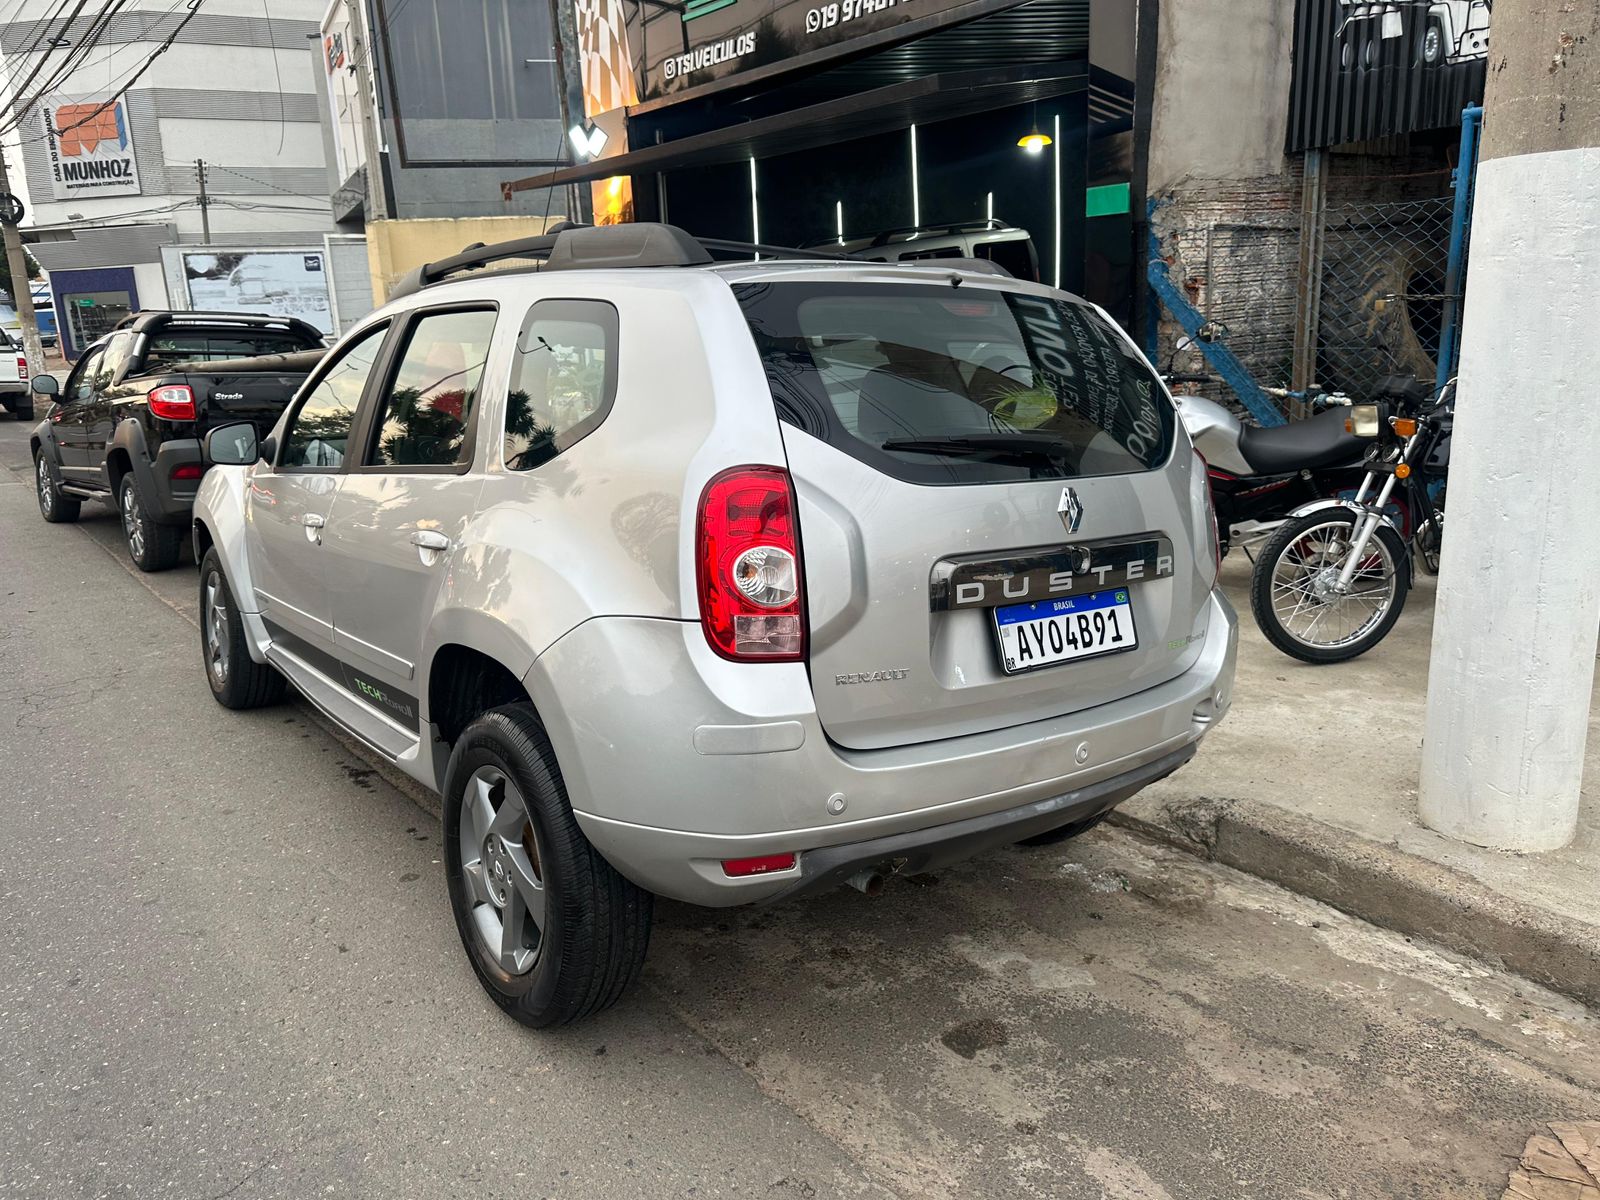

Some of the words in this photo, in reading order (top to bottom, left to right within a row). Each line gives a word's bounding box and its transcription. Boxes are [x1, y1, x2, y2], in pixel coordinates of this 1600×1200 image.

[821, 3, 840, 28] 19
[51, 151, 59, 161] DO
[53, 163, 61, 182] CASA
[62, 158, 133, 181] MUNHOZ
[214, 392, 243, 400] Strada
[956, 555, 1173, 604] DUSTER
[1053, 600, 1075, 611] BRASIL
[835, 668, 910, 685] RENAULT
